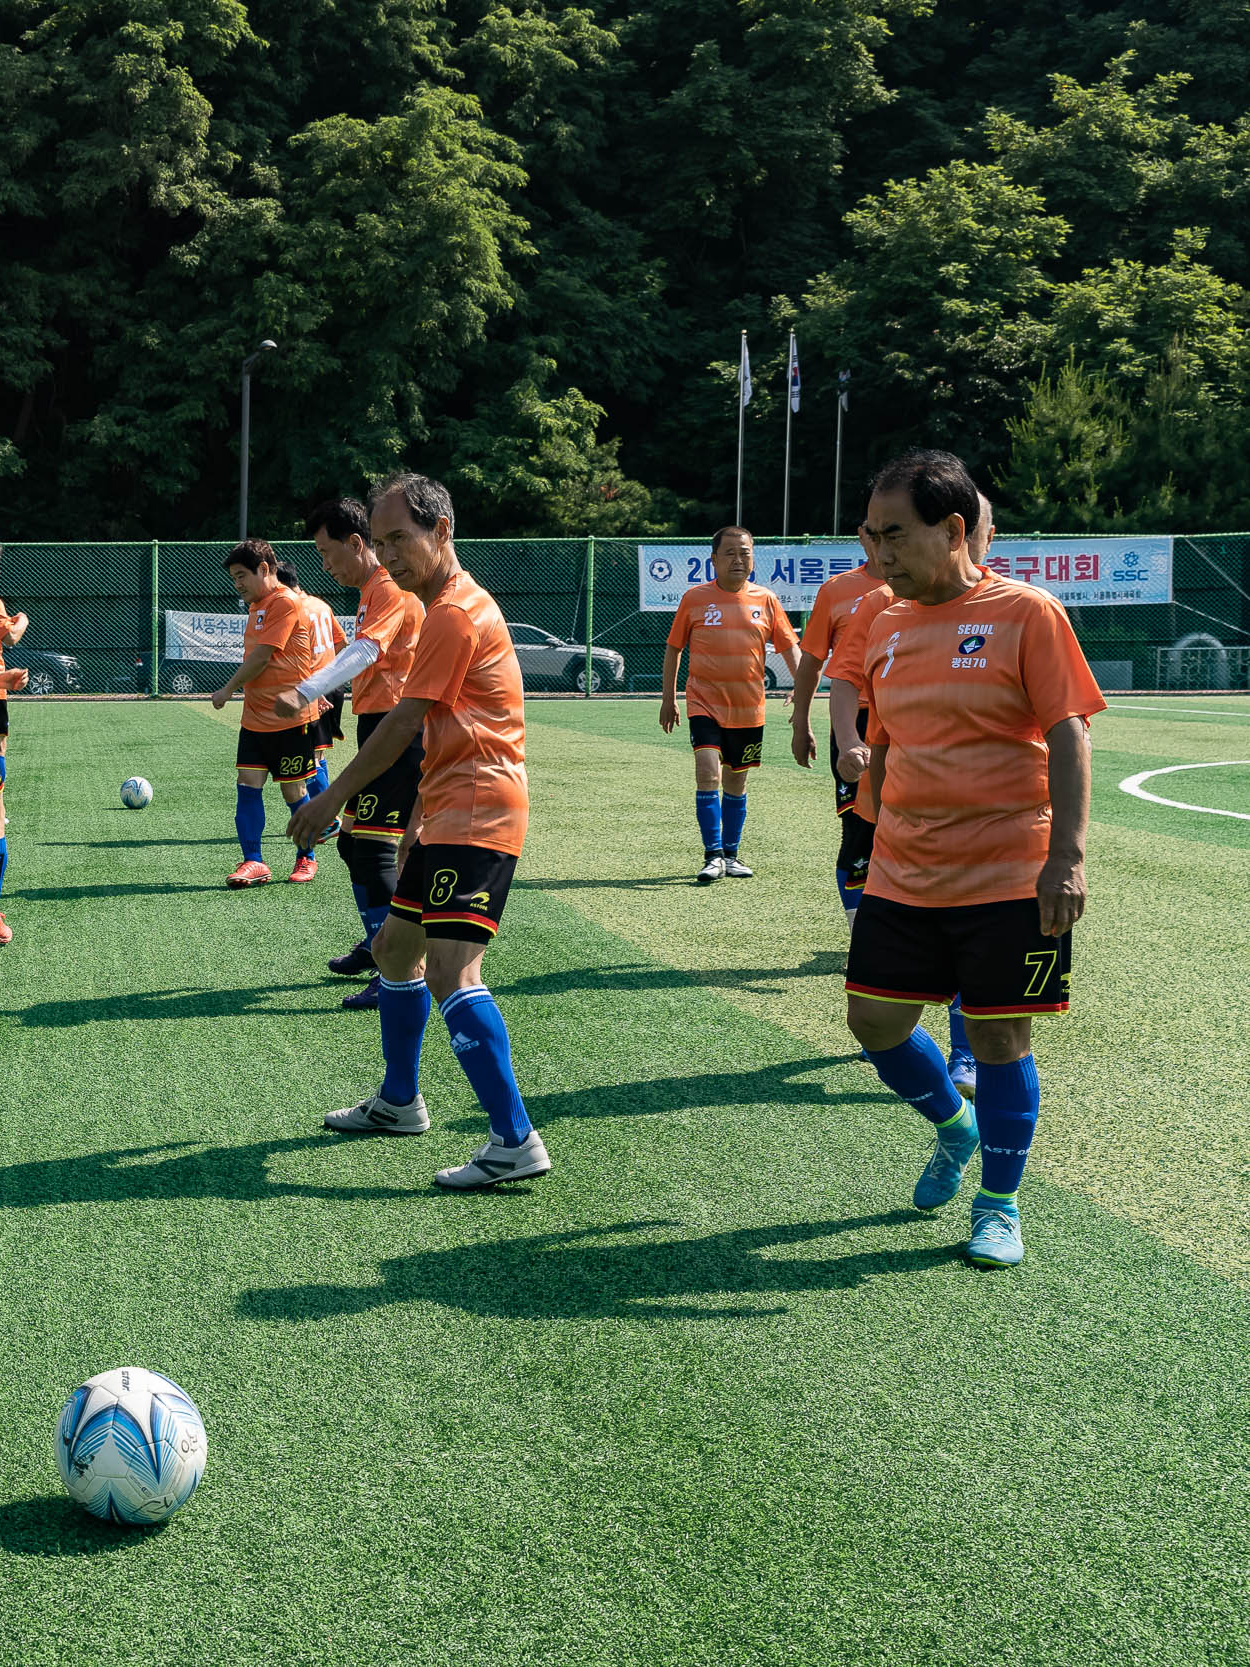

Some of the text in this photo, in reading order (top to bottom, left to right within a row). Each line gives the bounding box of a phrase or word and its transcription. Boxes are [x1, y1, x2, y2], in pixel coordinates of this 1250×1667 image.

[1113, 569, 1149, 582] SSC
[704, 610, 723, 626] 22
[957, 624, 994, 635] SEOUL
[951, 657, 987, 669] 광진70
[280, 755, 304, 775] 23
[430, 868, 458, 906] 8
[1023, 950, 1057, 997] 7
